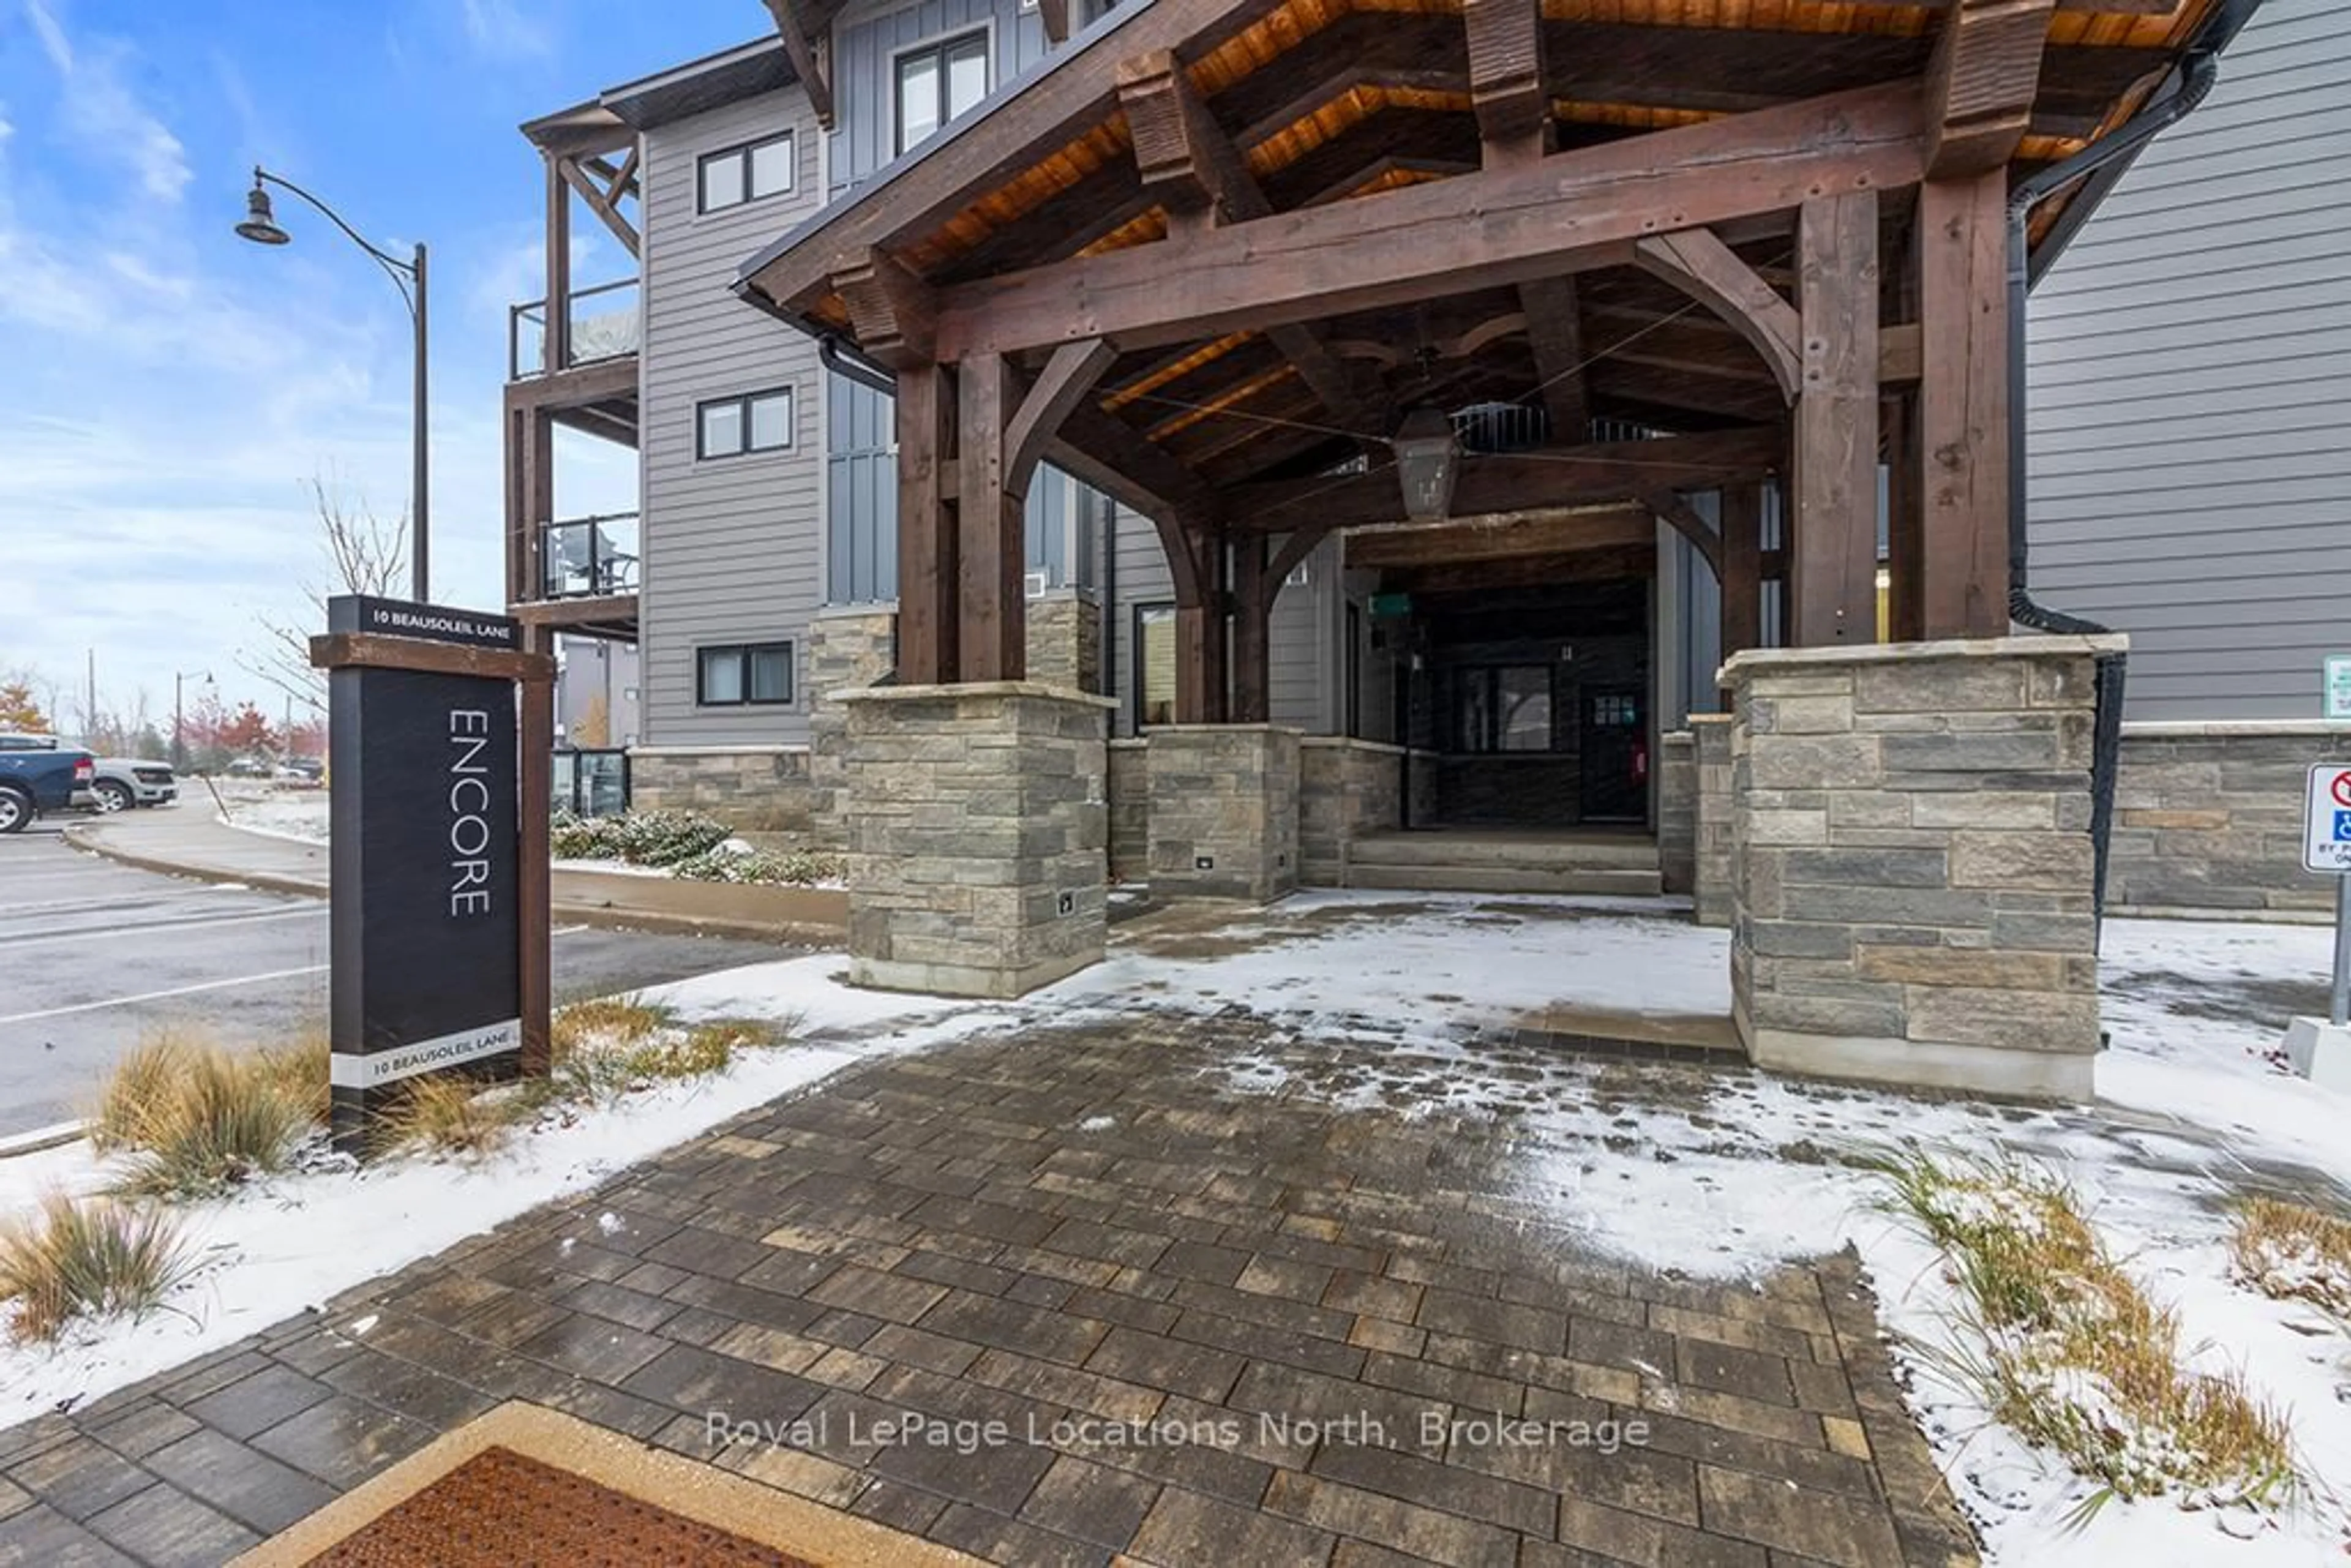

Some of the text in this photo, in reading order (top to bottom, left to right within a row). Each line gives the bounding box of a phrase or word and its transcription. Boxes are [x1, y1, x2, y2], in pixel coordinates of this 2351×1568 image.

[374, 610, 510, 639] 10 BEAUSOLEIL LANE
[450, 710, 489, 917] ENCORE
[374, 1032, 508, 1076] 10 BEAUSOLEIL LANE
